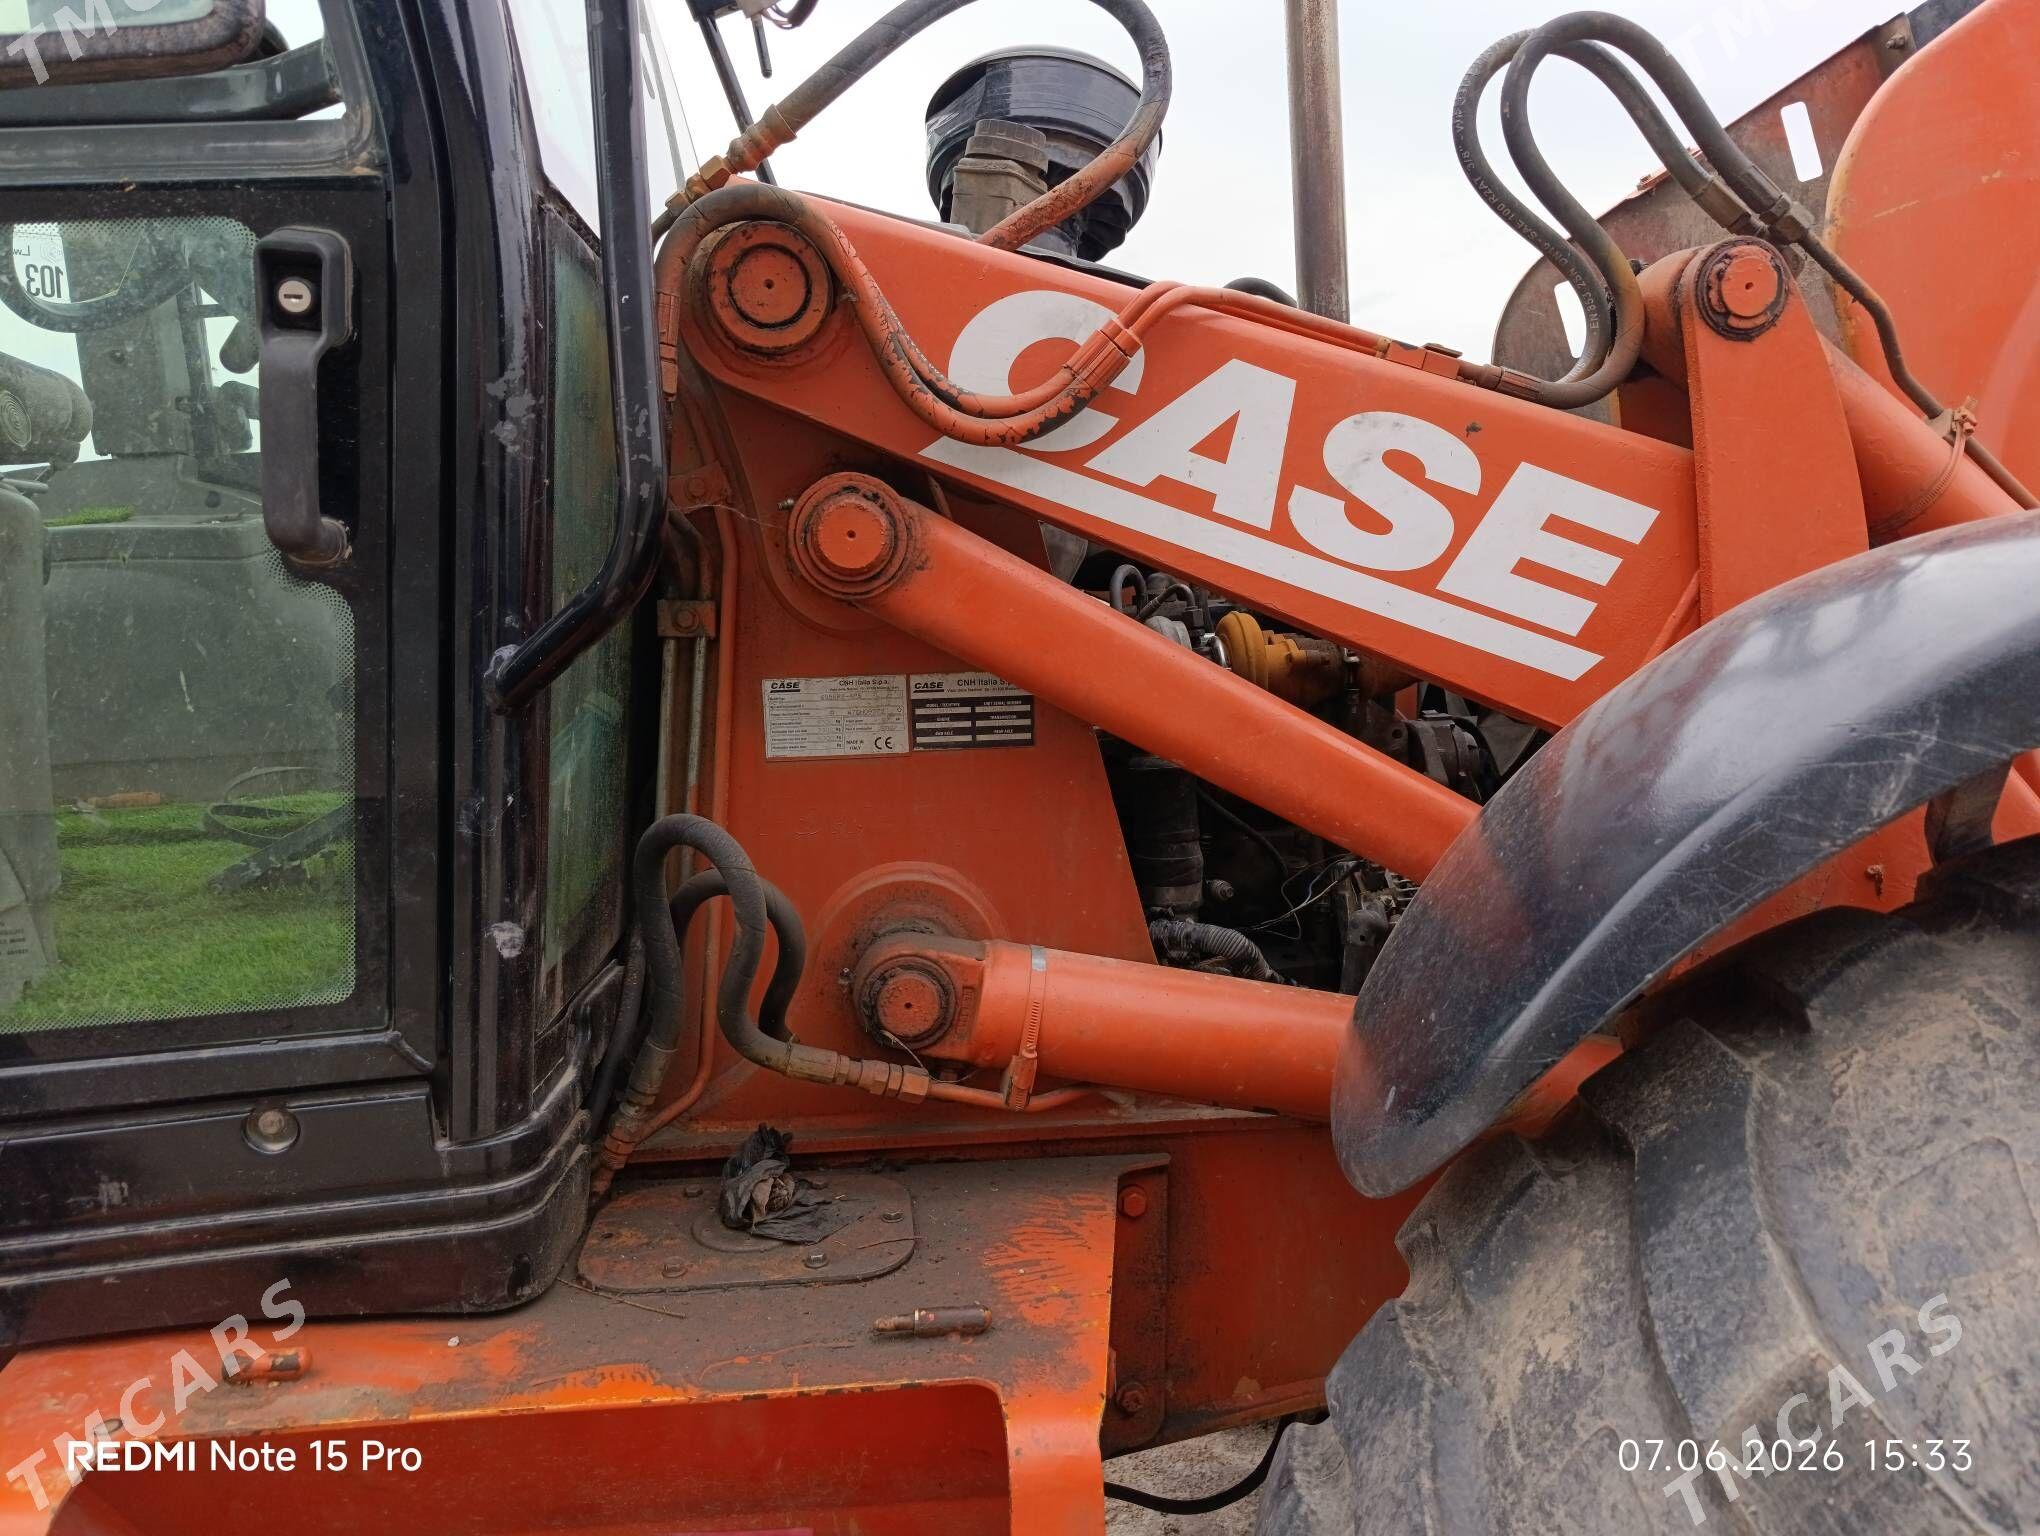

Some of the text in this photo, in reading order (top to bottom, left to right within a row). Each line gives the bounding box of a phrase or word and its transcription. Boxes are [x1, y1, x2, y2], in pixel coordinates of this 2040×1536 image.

[947, 289, 1660, 636] CASE
[770, 681, 800, 690] CASE
[914, 681, 944, 690] CASE
[957, 679, 976, 687] CNH
[978, 679, 998, 687] Italia
[874, 736, 893, 750] CE
